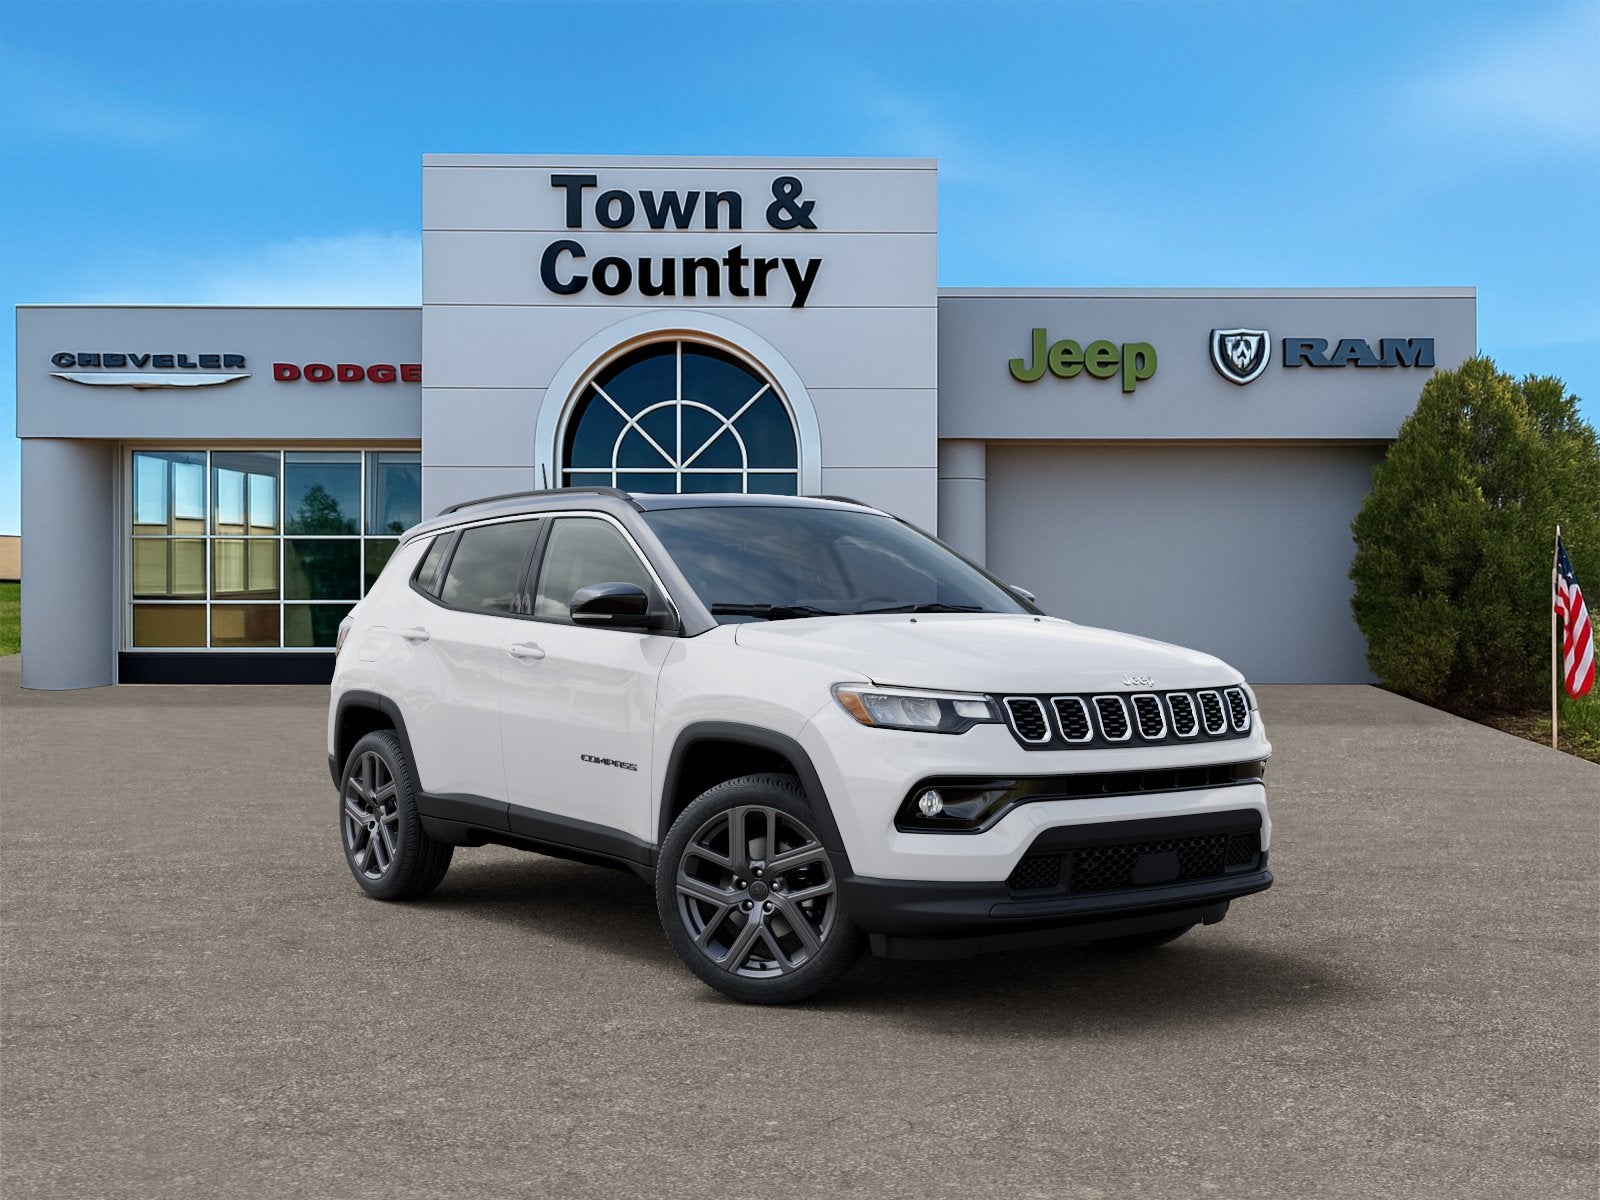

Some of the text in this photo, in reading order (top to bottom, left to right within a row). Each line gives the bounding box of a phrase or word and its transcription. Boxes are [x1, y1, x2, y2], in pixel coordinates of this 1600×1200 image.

[550, 174, 818, 230] Town &
[540, 239, 822, 308] Country
[1009, 327, 1157, 392] Jeep
[1282, 337, 1436, 368] RAM
[273, 362, 422, 382] DODGE
[1122, 673, 1154, 687] Jeep
[580, 754, 638, 771] COMPASS
